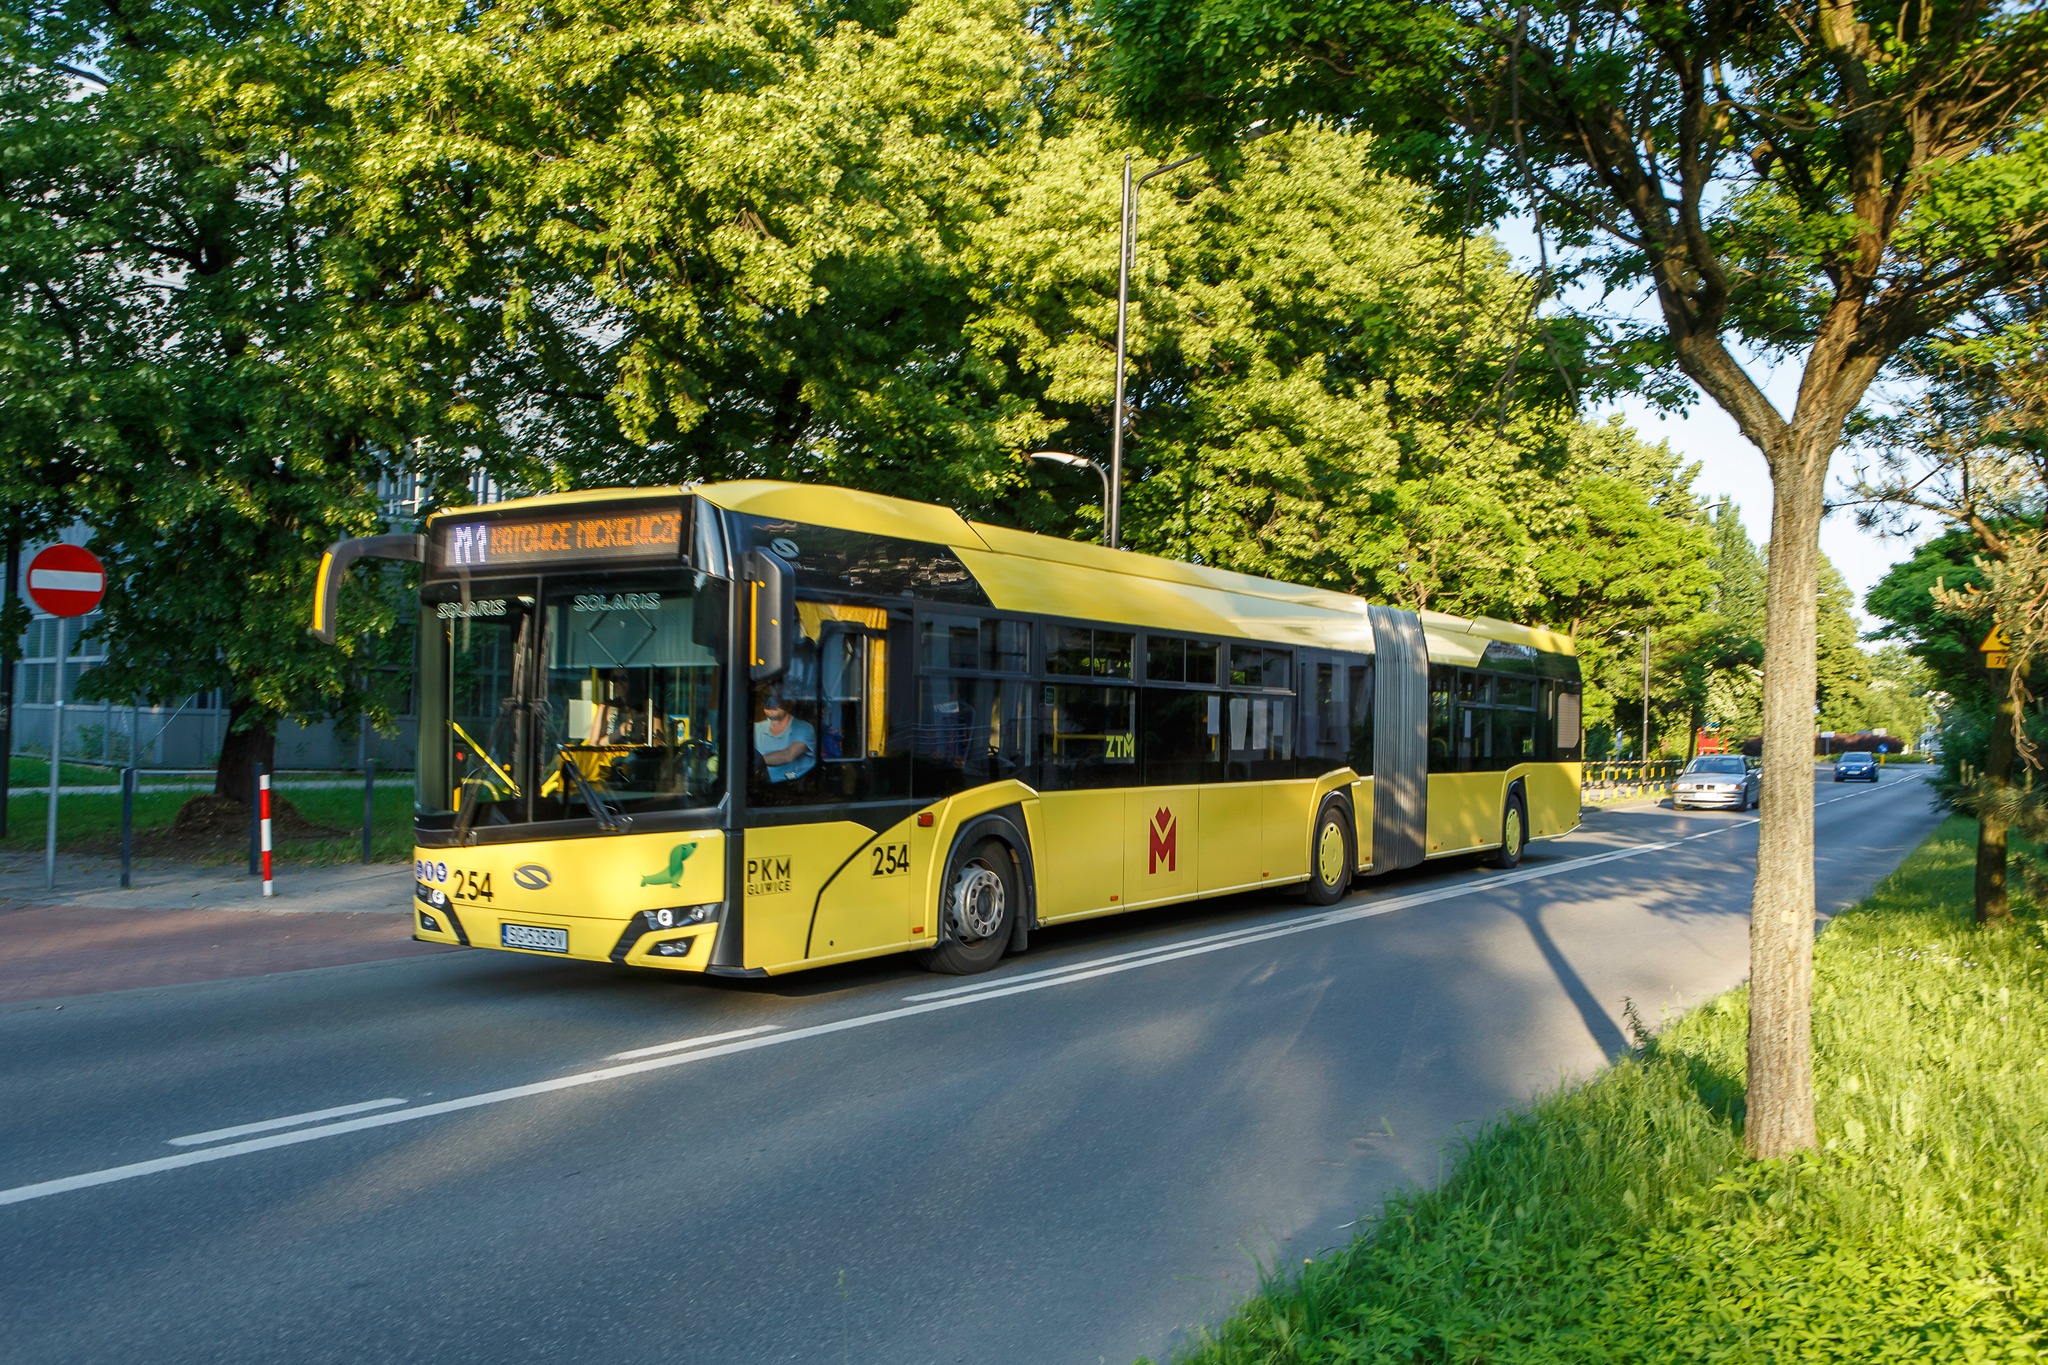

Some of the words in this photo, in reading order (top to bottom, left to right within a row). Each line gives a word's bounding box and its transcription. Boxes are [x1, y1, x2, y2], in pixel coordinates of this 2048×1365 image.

[454, 525, 487, 563] M1
[491, 522, 571, 554] KATOWICE
[437, 599, 507, 619] SOLARIS
[573, 593, 661, 612] SOLARIS
[1105, 732, 1135, 758] ZTM
[747, 857, 791, 883] PKM
[872, 843, 910, 876] 254
[453, 869, 494, 902] 254
[747, 880, 791, 896] GLIWICE
